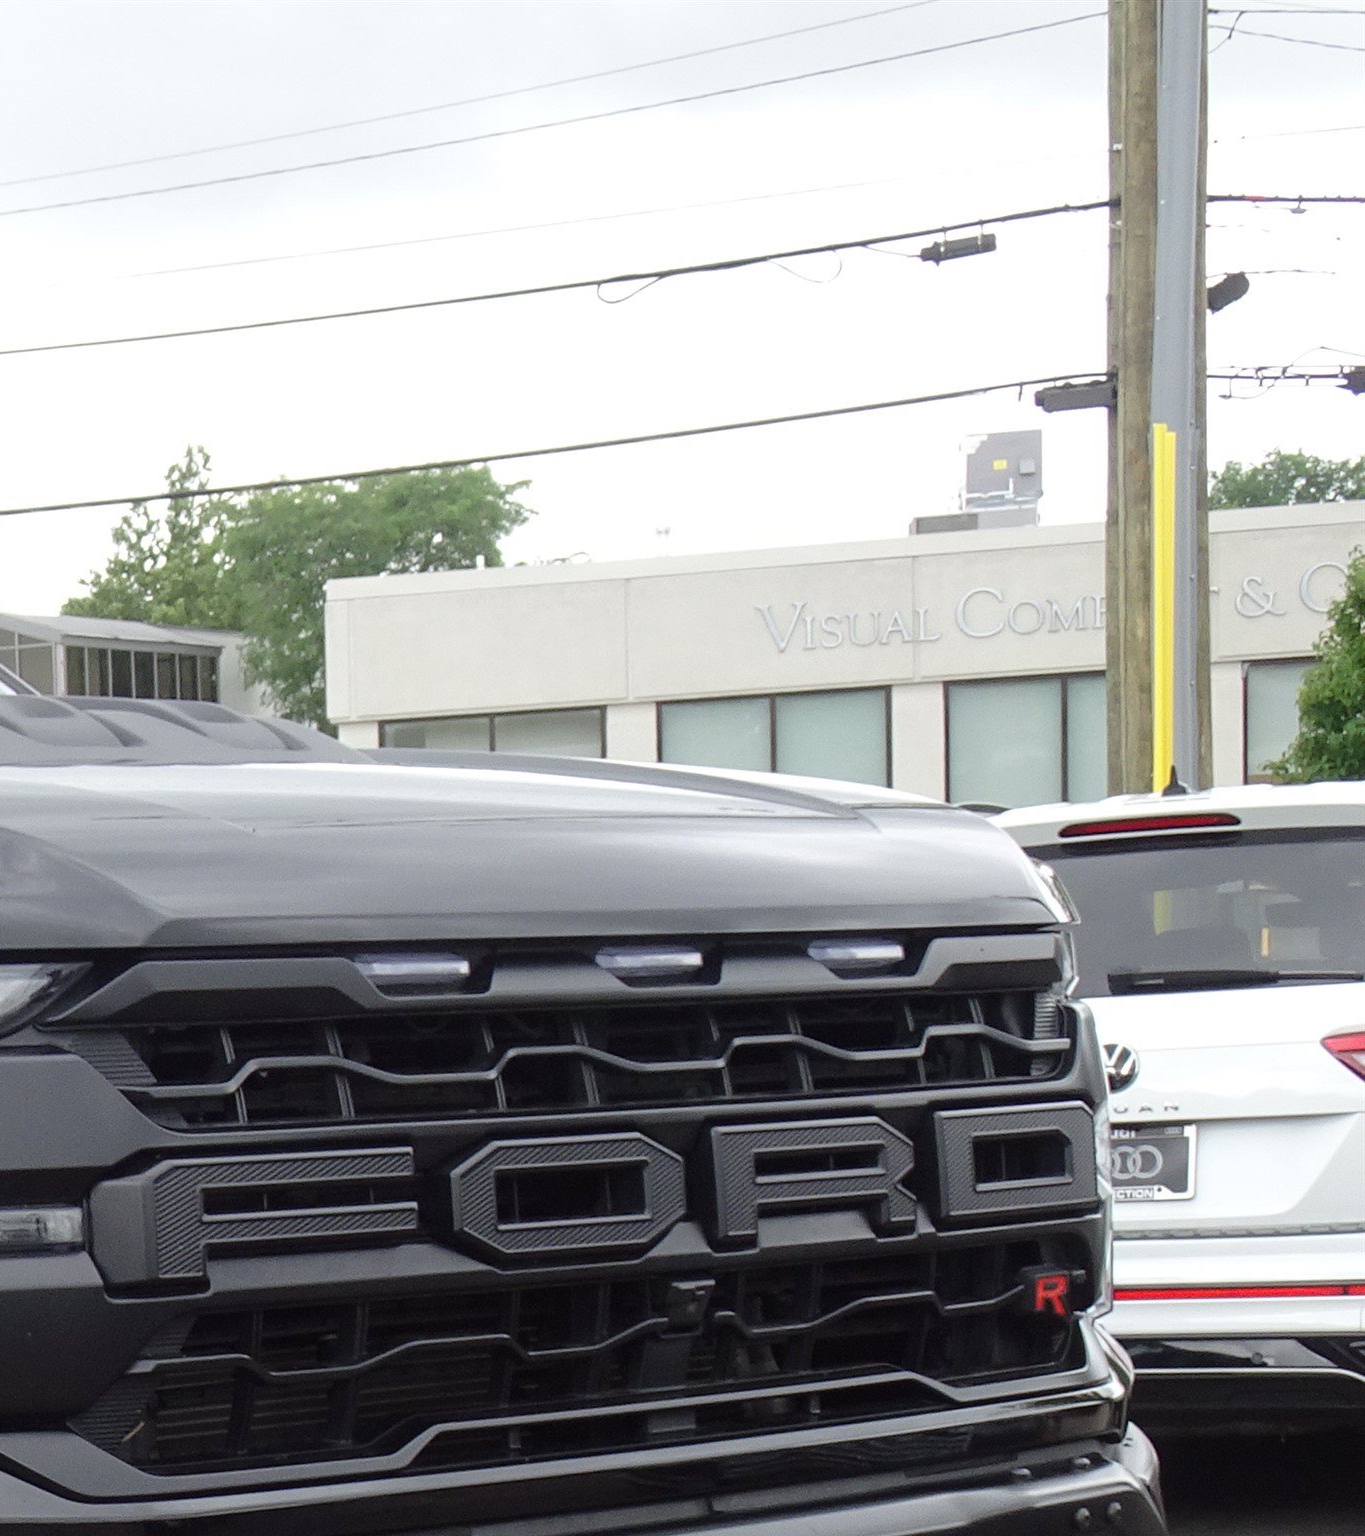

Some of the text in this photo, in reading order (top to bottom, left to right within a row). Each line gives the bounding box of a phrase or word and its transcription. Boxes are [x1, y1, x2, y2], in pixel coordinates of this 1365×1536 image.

[1235, 576, 1286, 618] &
[1113, 1101, 1180, 1114] UAN
[90, 1102, 1098, 1294] FORD
[1035, 1273, 1068, 1317] R
